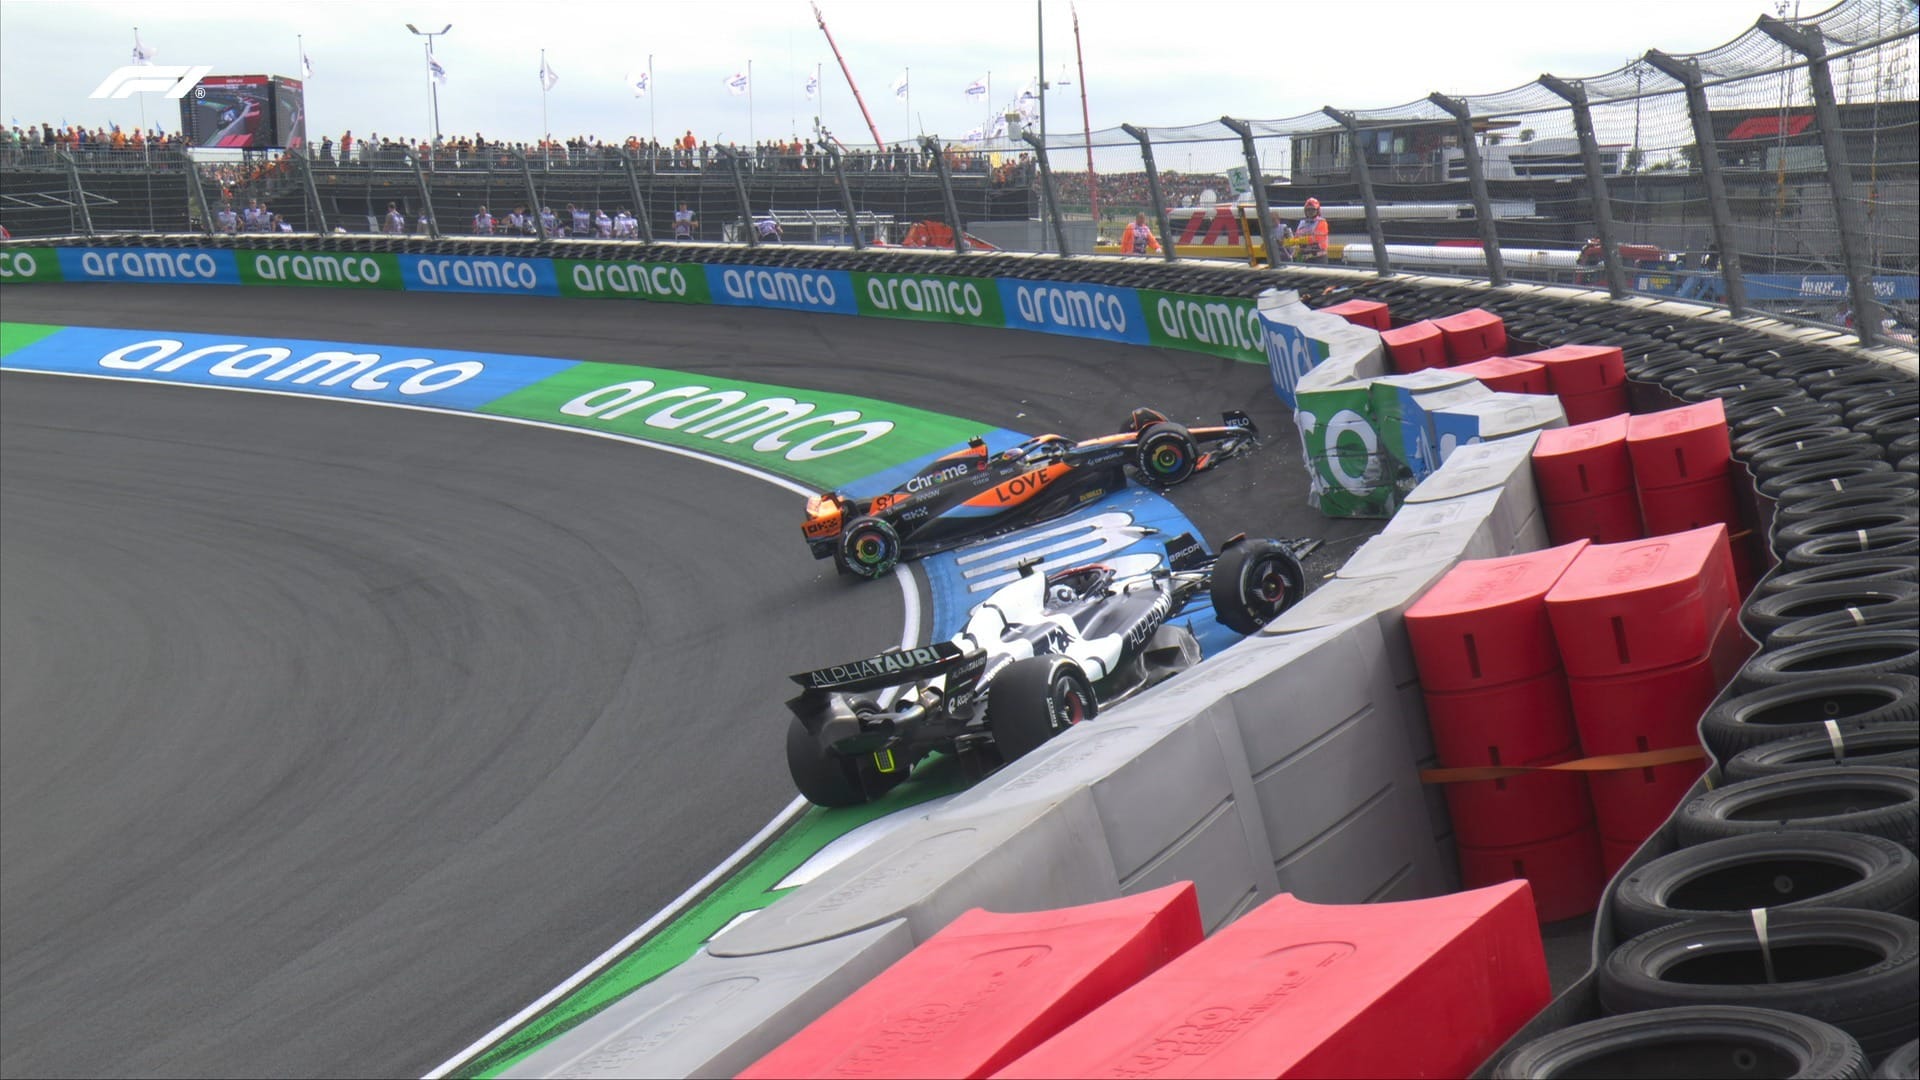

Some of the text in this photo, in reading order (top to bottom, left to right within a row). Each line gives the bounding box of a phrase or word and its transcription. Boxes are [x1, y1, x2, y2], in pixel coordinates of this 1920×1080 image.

[82, 252, 217, 279] aramco
[256, 254, 380, 283] aramco
[417, 257, 536, 290] aramco
[573, 263, 686, 297] aramco
[723, 269, 836, 306] aramco
[867, 277, 982, 318] aramco
[1017, 286, 1126, 333] aramco
[1157, 298, 1265, 353] aramco
[98, 339, 484, 395] aramco
[560, 380, 895, 461] aramco
[906, 463, 968, 493] Chrome
[996, 468, 1050, 503] LOVE
[811, 645, 942, 686] ALPHATAURI
